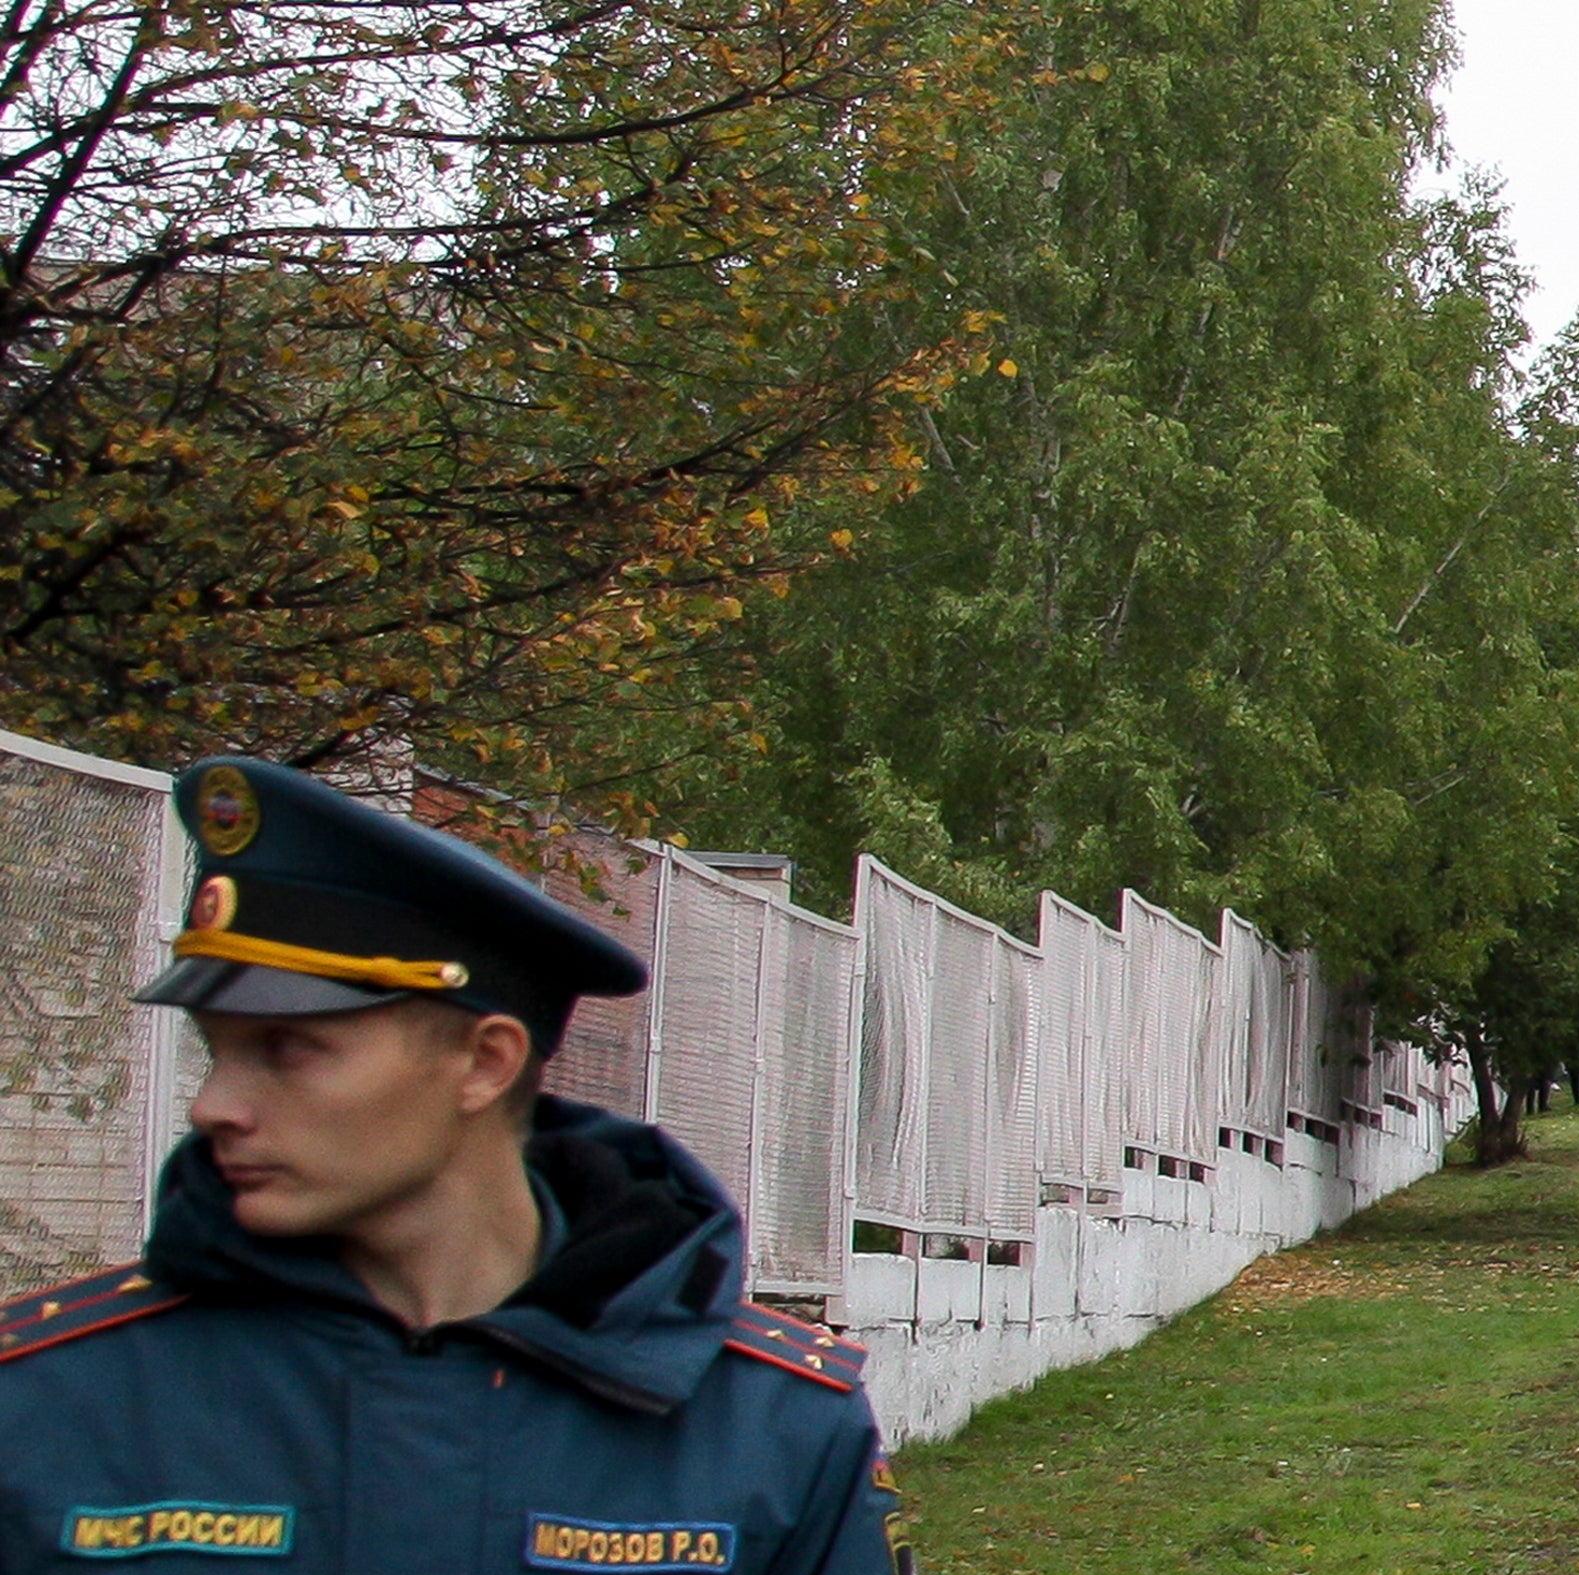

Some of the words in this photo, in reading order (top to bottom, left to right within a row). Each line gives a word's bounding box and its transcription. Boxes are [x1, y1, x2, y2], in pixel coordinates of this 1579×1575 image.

[74, 1515, 145, 1548] МЧС
[149, 1510, 285, 1546] РОССИИ
[534, 1521, 664, 1564] МОРОЗОВ
[670, 1530, 726, 1566] Р.О.
